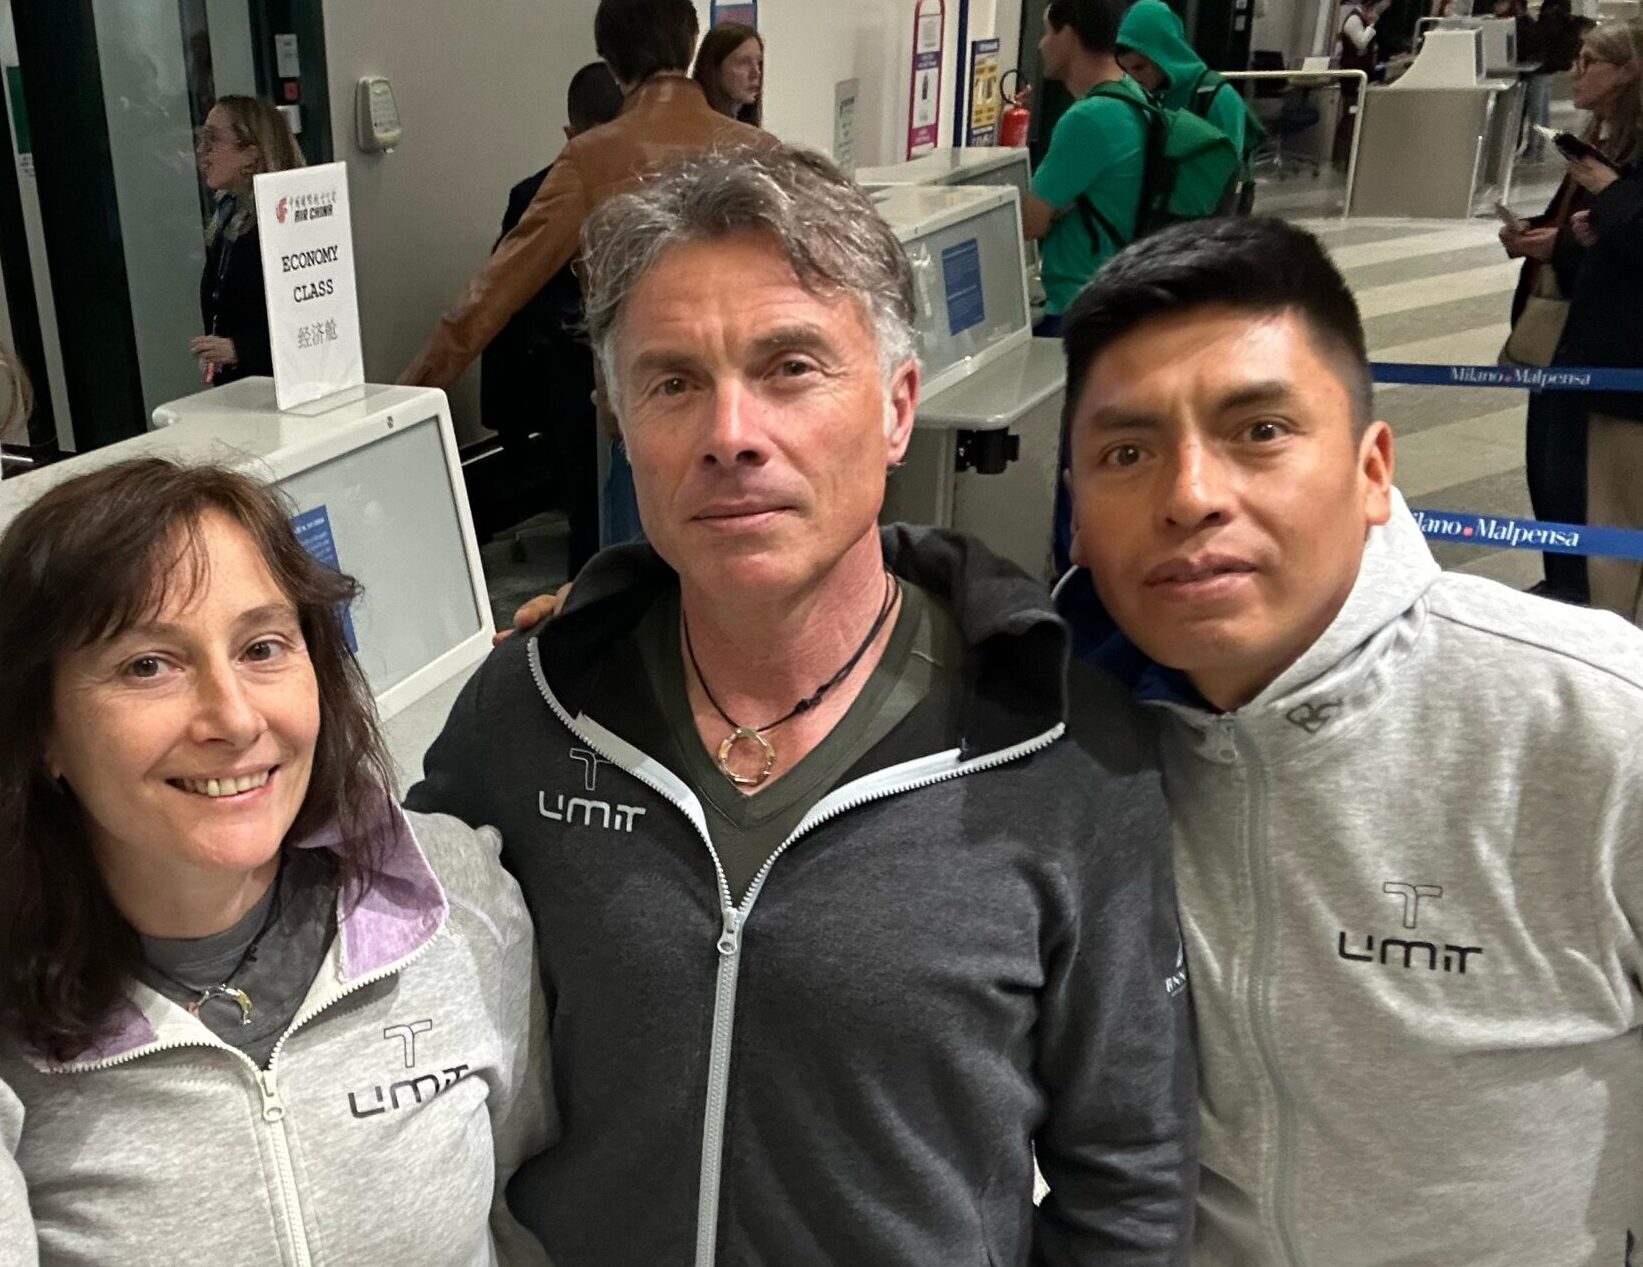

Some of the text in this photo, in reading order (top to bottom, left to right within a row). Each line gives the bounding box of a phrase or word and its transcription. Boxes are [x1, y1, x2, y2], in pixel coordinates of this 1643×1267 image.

[294, 208, 308, 222] AIR
[281, 244, 338, 273] ECONOMY
[293, 278, 334, 303] CLASS
[1450, 366, 1592, 387] Milano Malpensa
[1412, 511, 1580, 547] lano Malpensa
